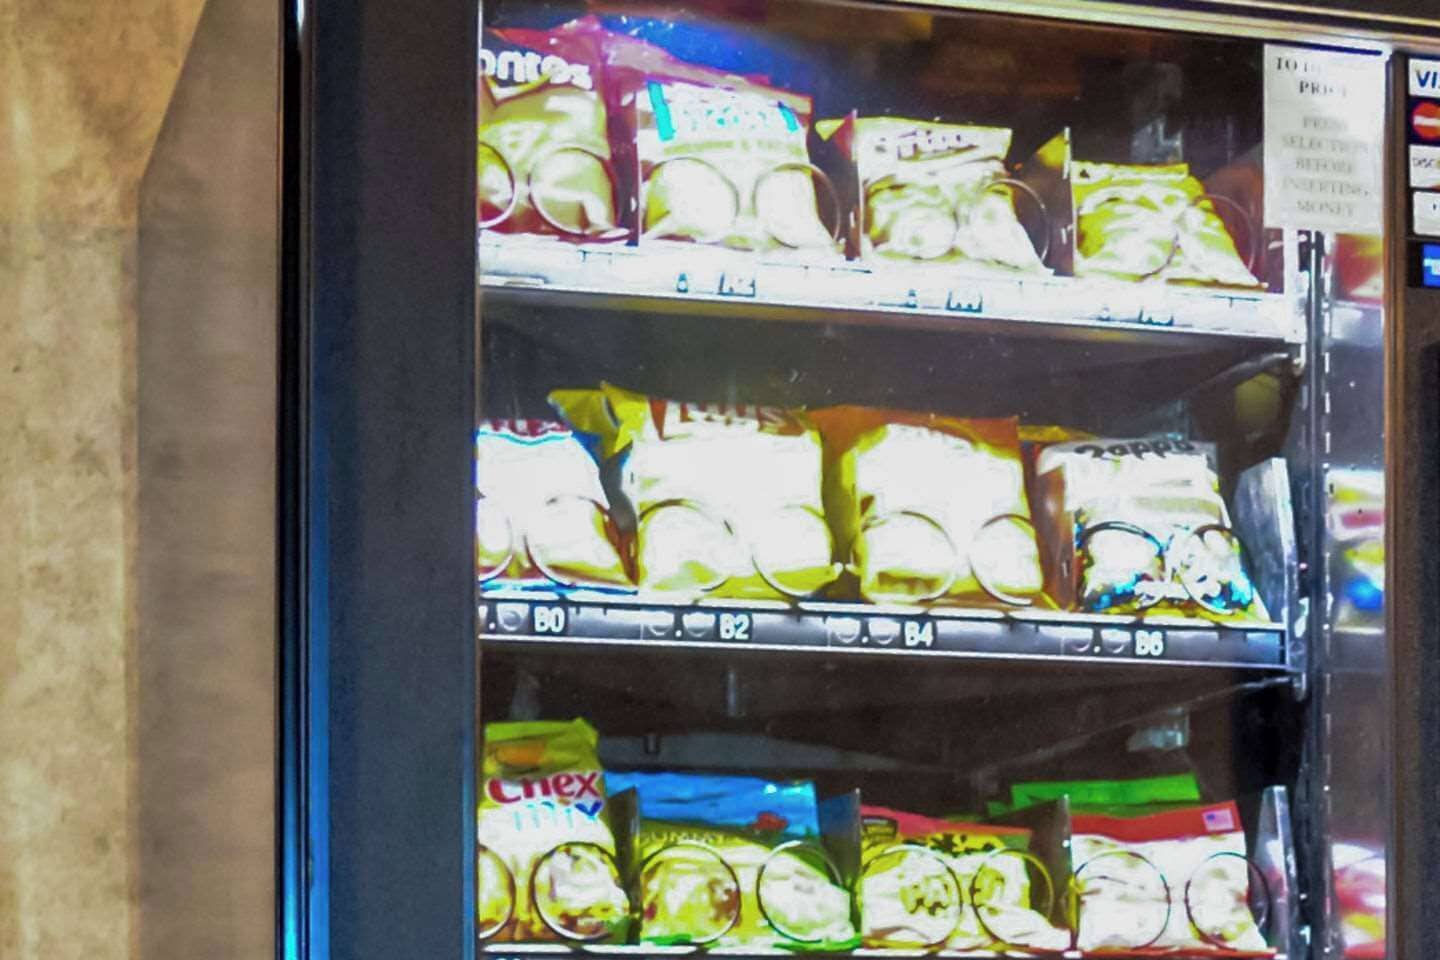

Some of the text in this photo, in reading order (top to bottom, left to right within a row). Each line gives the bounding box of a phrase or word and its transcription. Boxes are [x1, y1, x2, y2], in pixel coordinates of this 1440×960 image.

[534, 607, 565, 632] B0
[720, 614, 749, 639] B2
[905, 622, 934, 647] B4
[1135, 631, 1163, 656] B6
[487, 772, 601, 803] Chex
